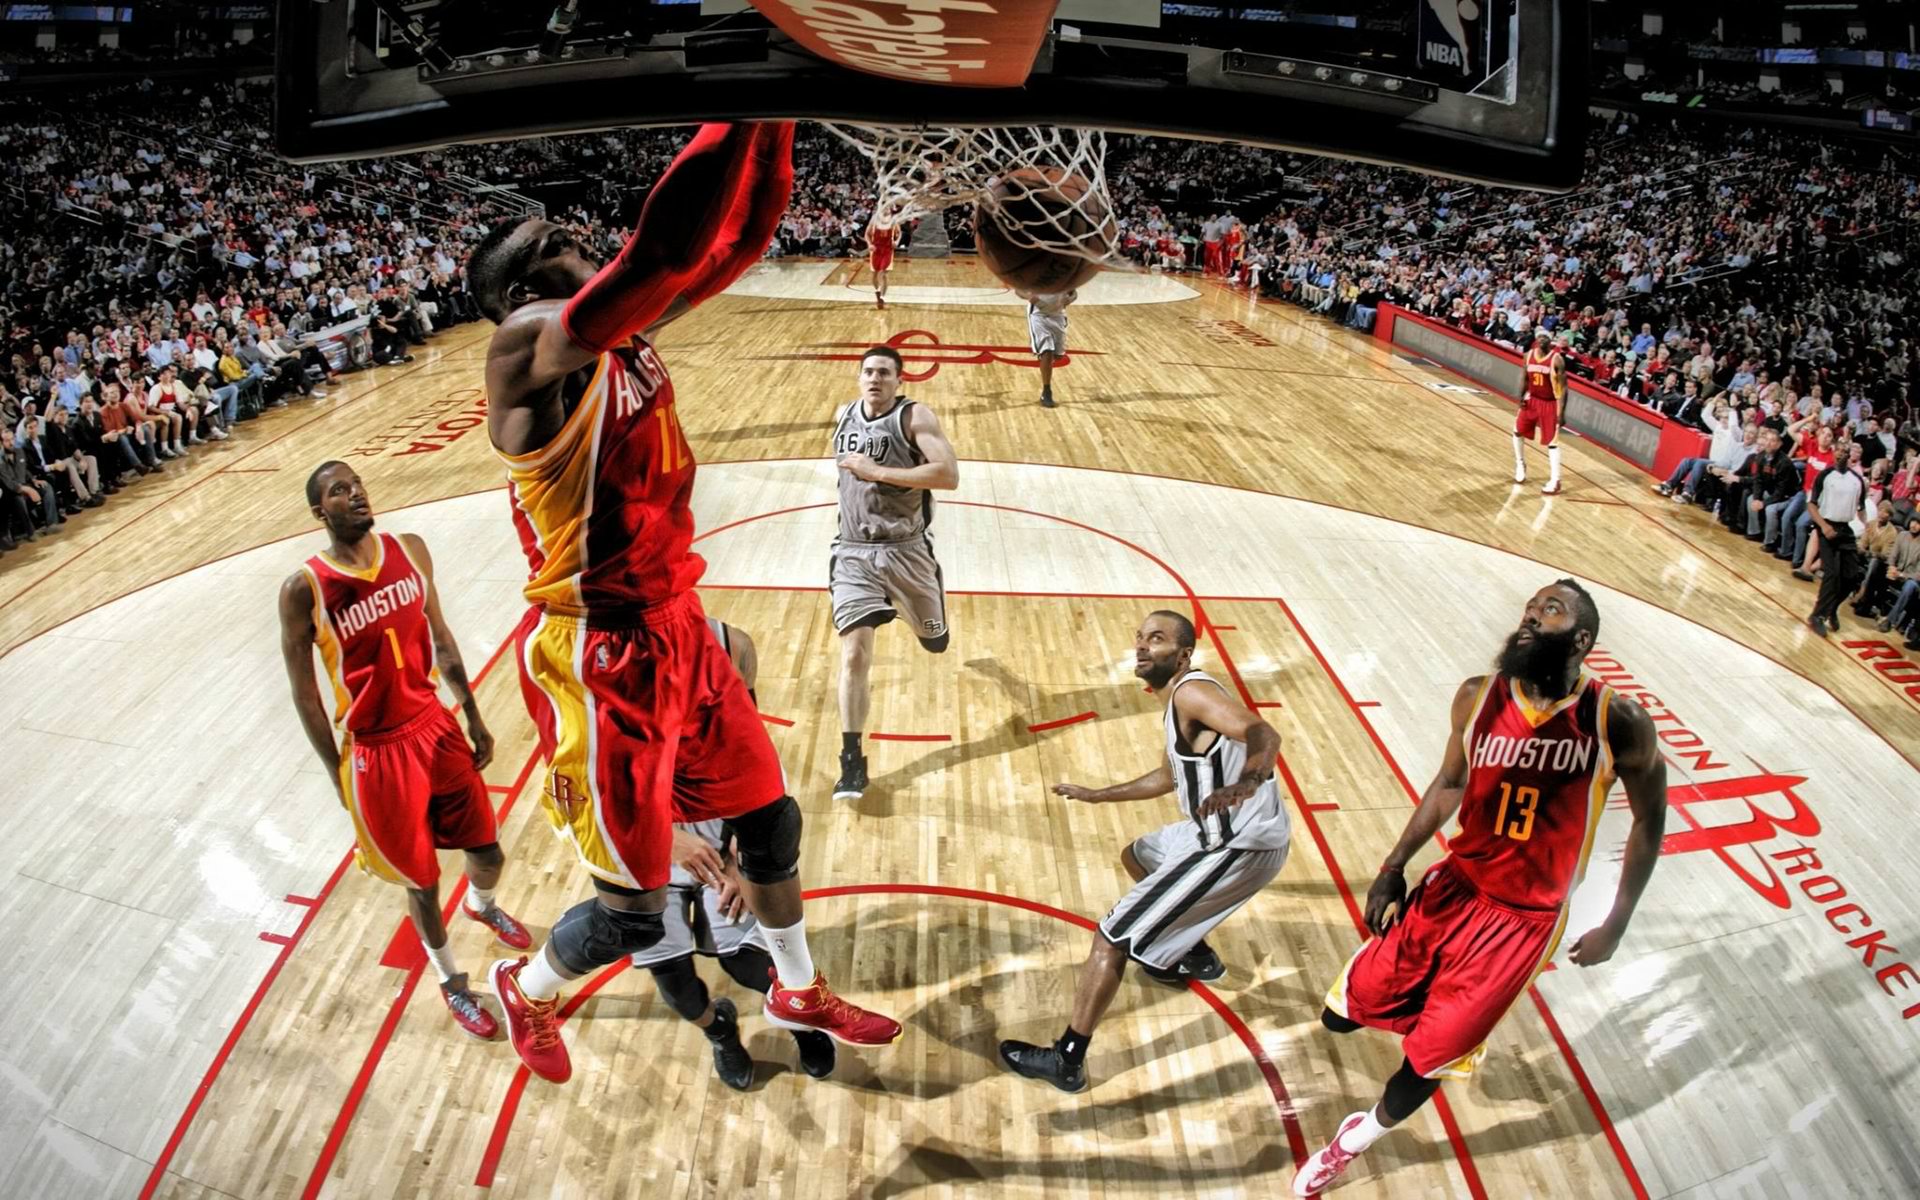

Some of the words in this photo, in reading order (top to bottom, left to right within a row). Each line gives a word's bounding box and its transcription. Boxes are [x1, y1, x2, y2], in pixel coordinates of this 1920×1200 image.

[1426, 41, 1460, 67] NBA
[1533, 372, 1543, 386] 31
[839, 433, 859, 453] 16
[1591, 405, 1626, 442] TIME
[334, 571, 420, 640] HOUSTON
[384, 627, 405, 669] 1
[1472, 732, 1592, 774] HOUSTON
[1494, 781, 1539, 841] 13
